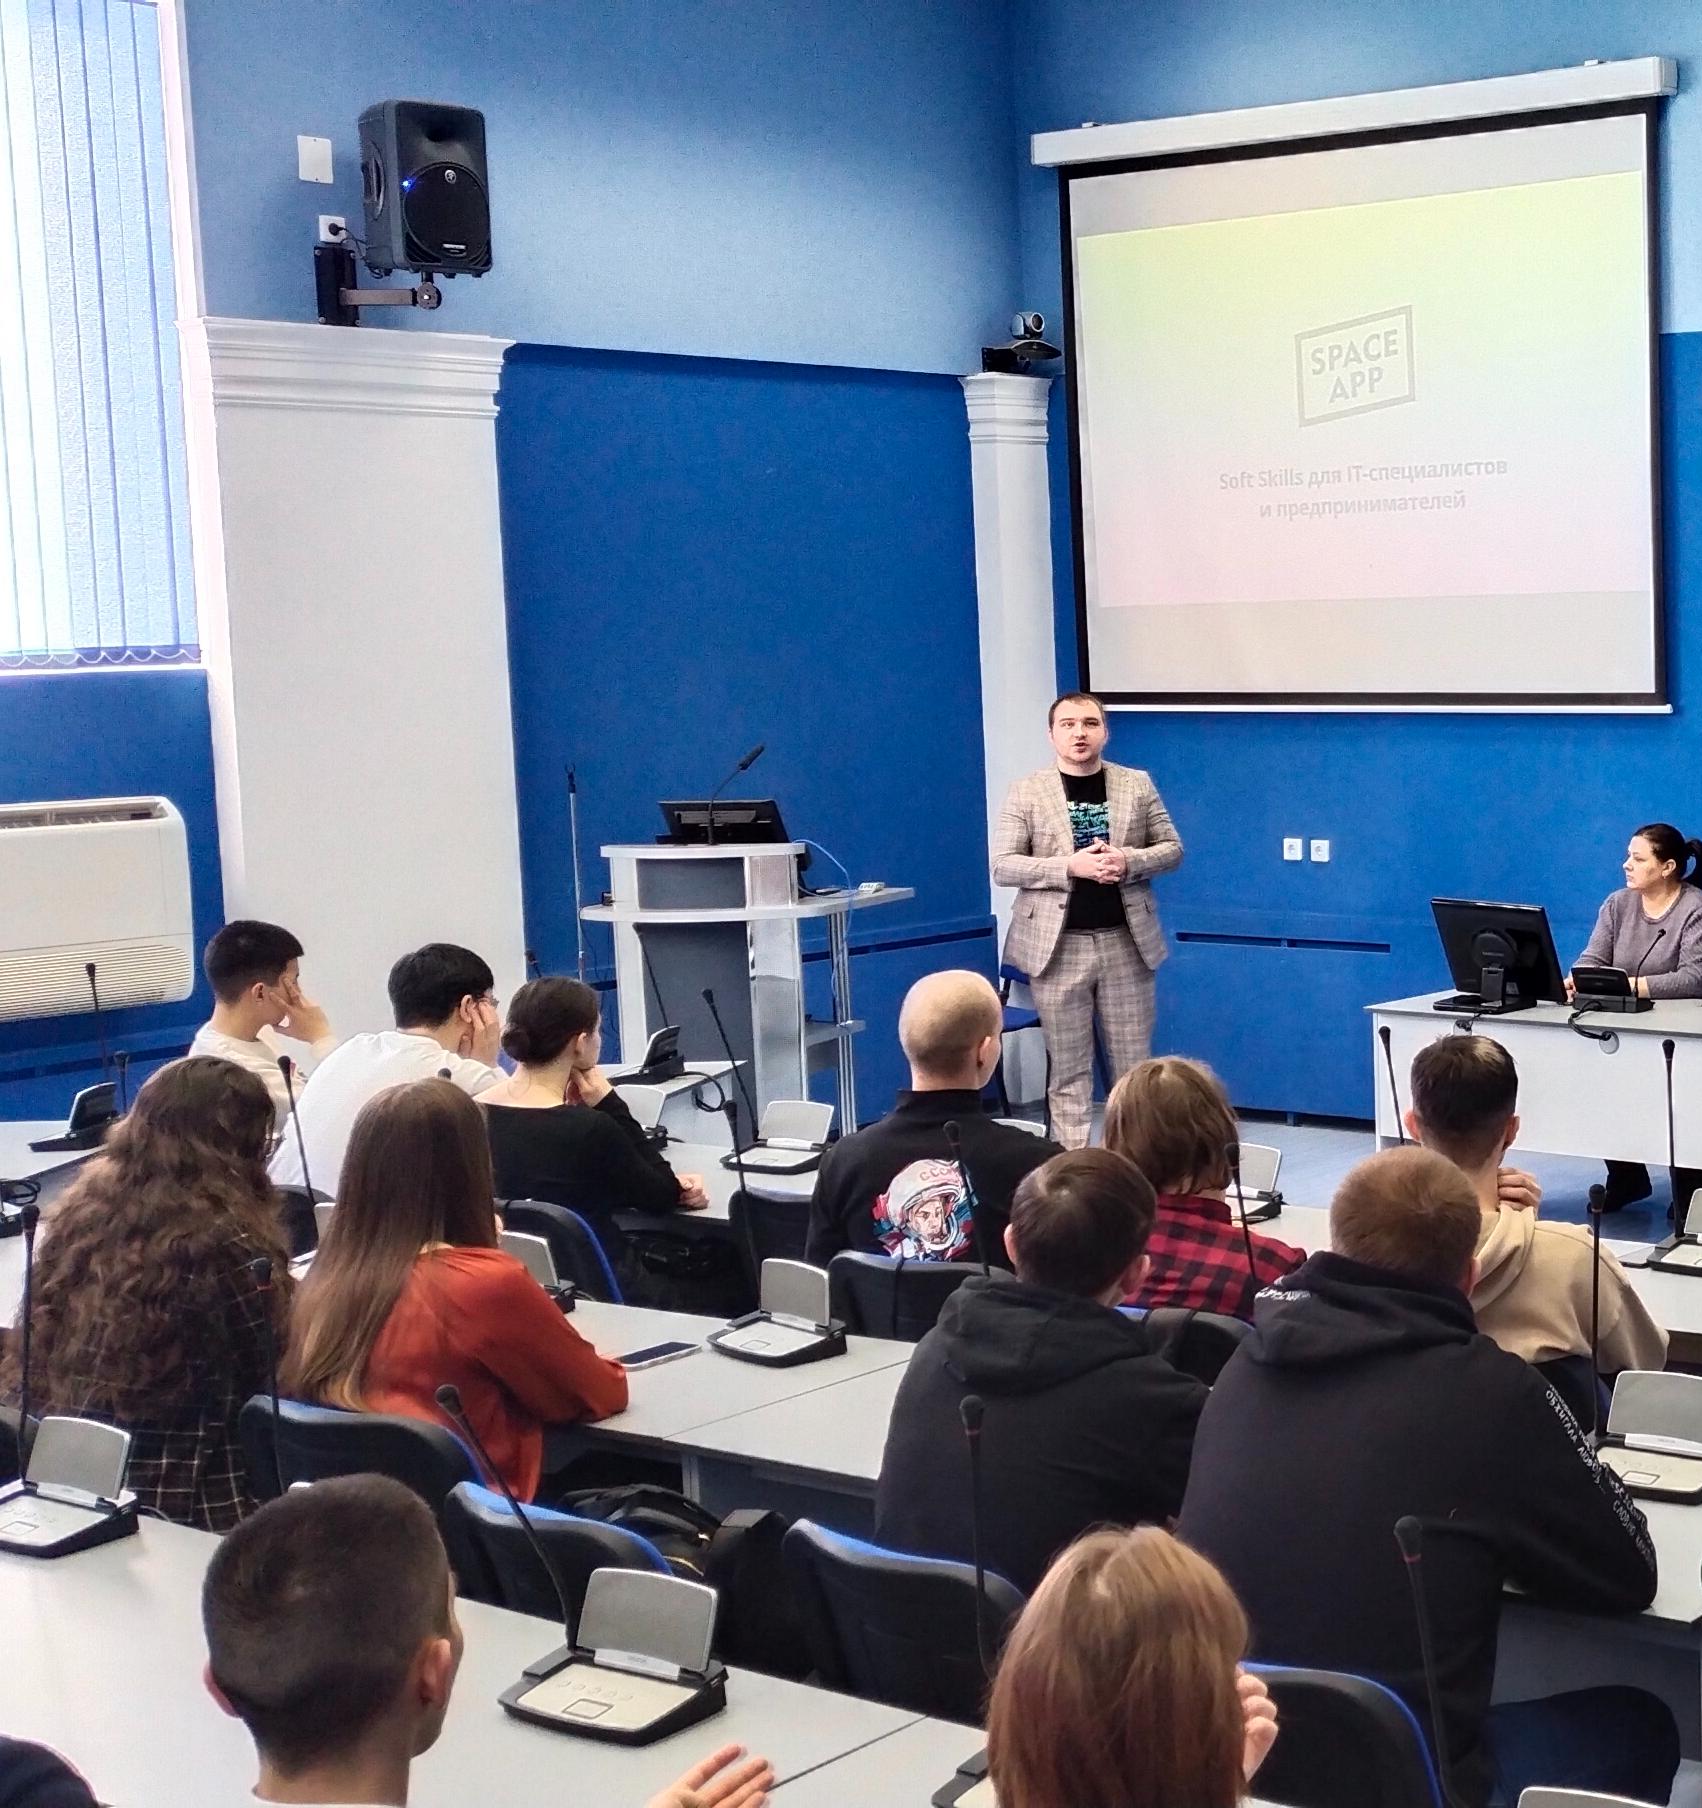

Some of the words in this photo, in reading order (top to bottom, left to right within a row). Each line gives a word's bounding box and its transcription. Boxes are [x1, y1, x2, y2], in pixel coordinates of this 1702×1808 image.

[1310, 328, 1400, 376] SPACE
[1328, 366, 1384, 404] APP
[1219, 471, 1255, 490] Soft
[1258, 469, 1304, 488] Skills
[1308, 471, 1342, 489] для
[1347, 459, 1508, 485] IT-специалистов
[1260, 504, 1272, 518] и
[1277, 490, 1467, 522] предпринимателей
